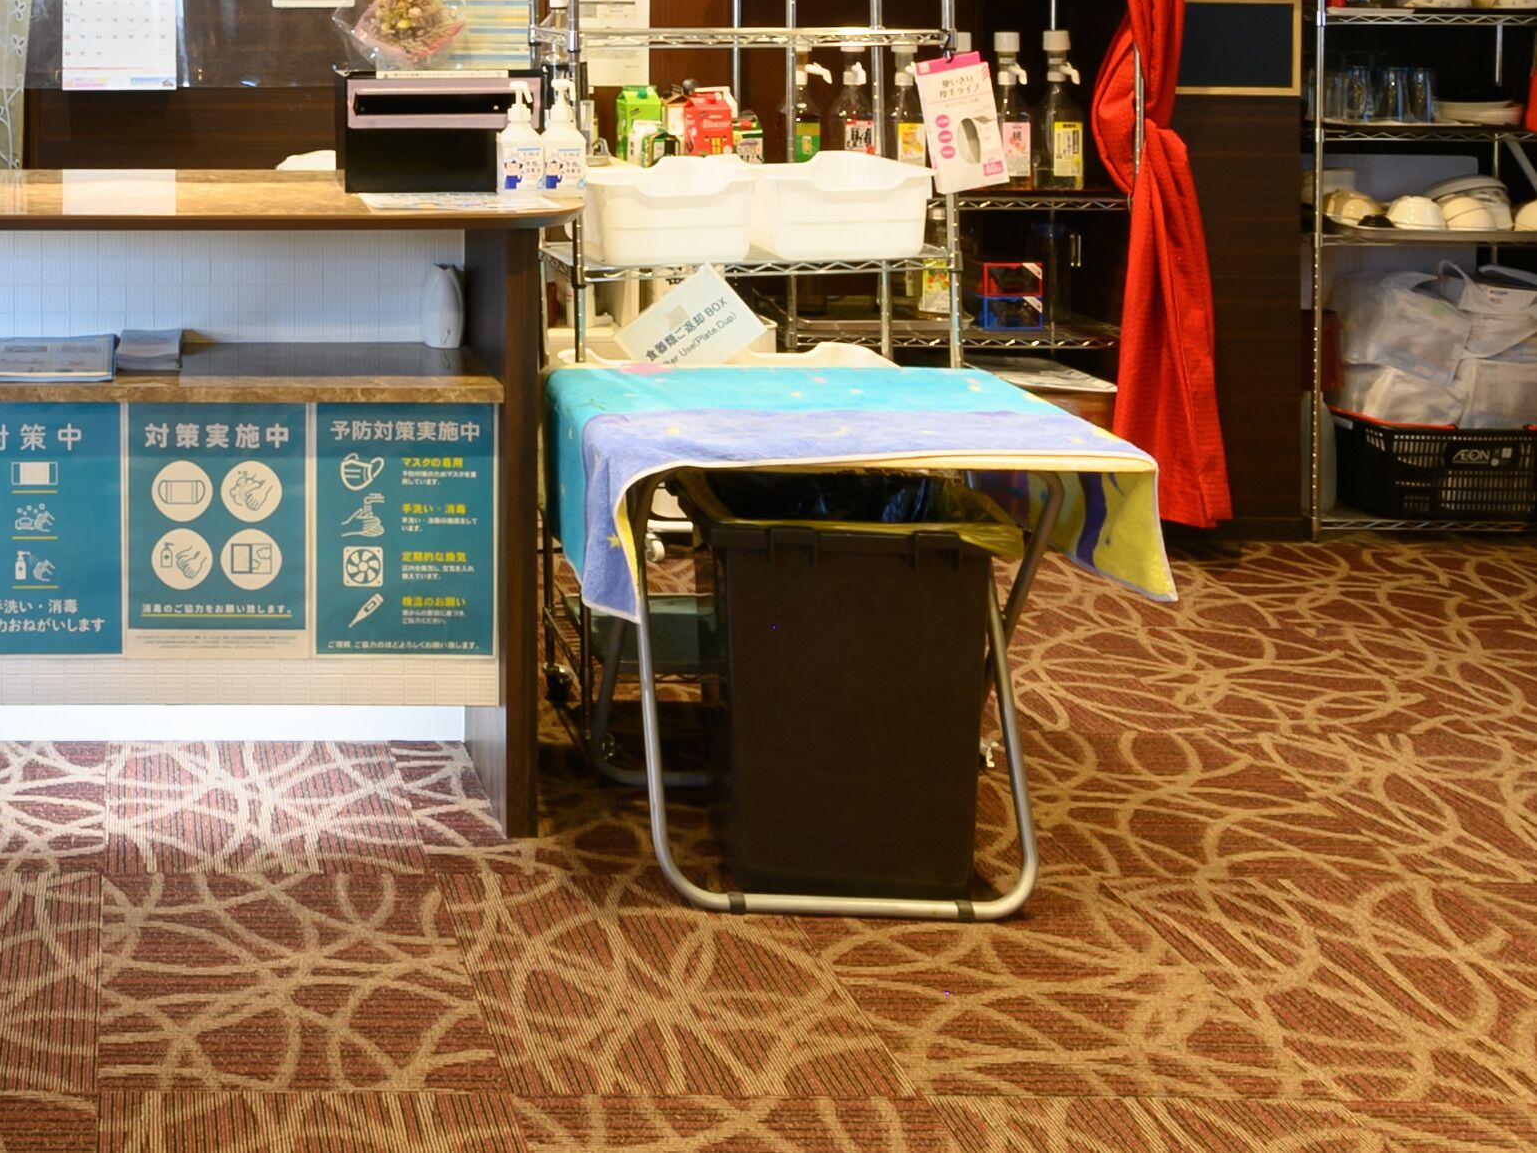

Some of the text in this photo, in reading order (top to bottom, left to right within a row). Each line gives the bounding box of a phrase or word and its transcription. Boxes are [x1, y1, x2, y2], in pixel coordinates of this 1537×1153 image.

[704, 297, 728, 318] BOX
[144, 423, 290, 449] 対策実施中
[330, 420, 481, 442] 予防対策実施中
[402, 457, 463, 468] マスクの着用
[402, 551, 467, 563] 定期的な換気
[402, 596, 466, 607] 検温のお願い
